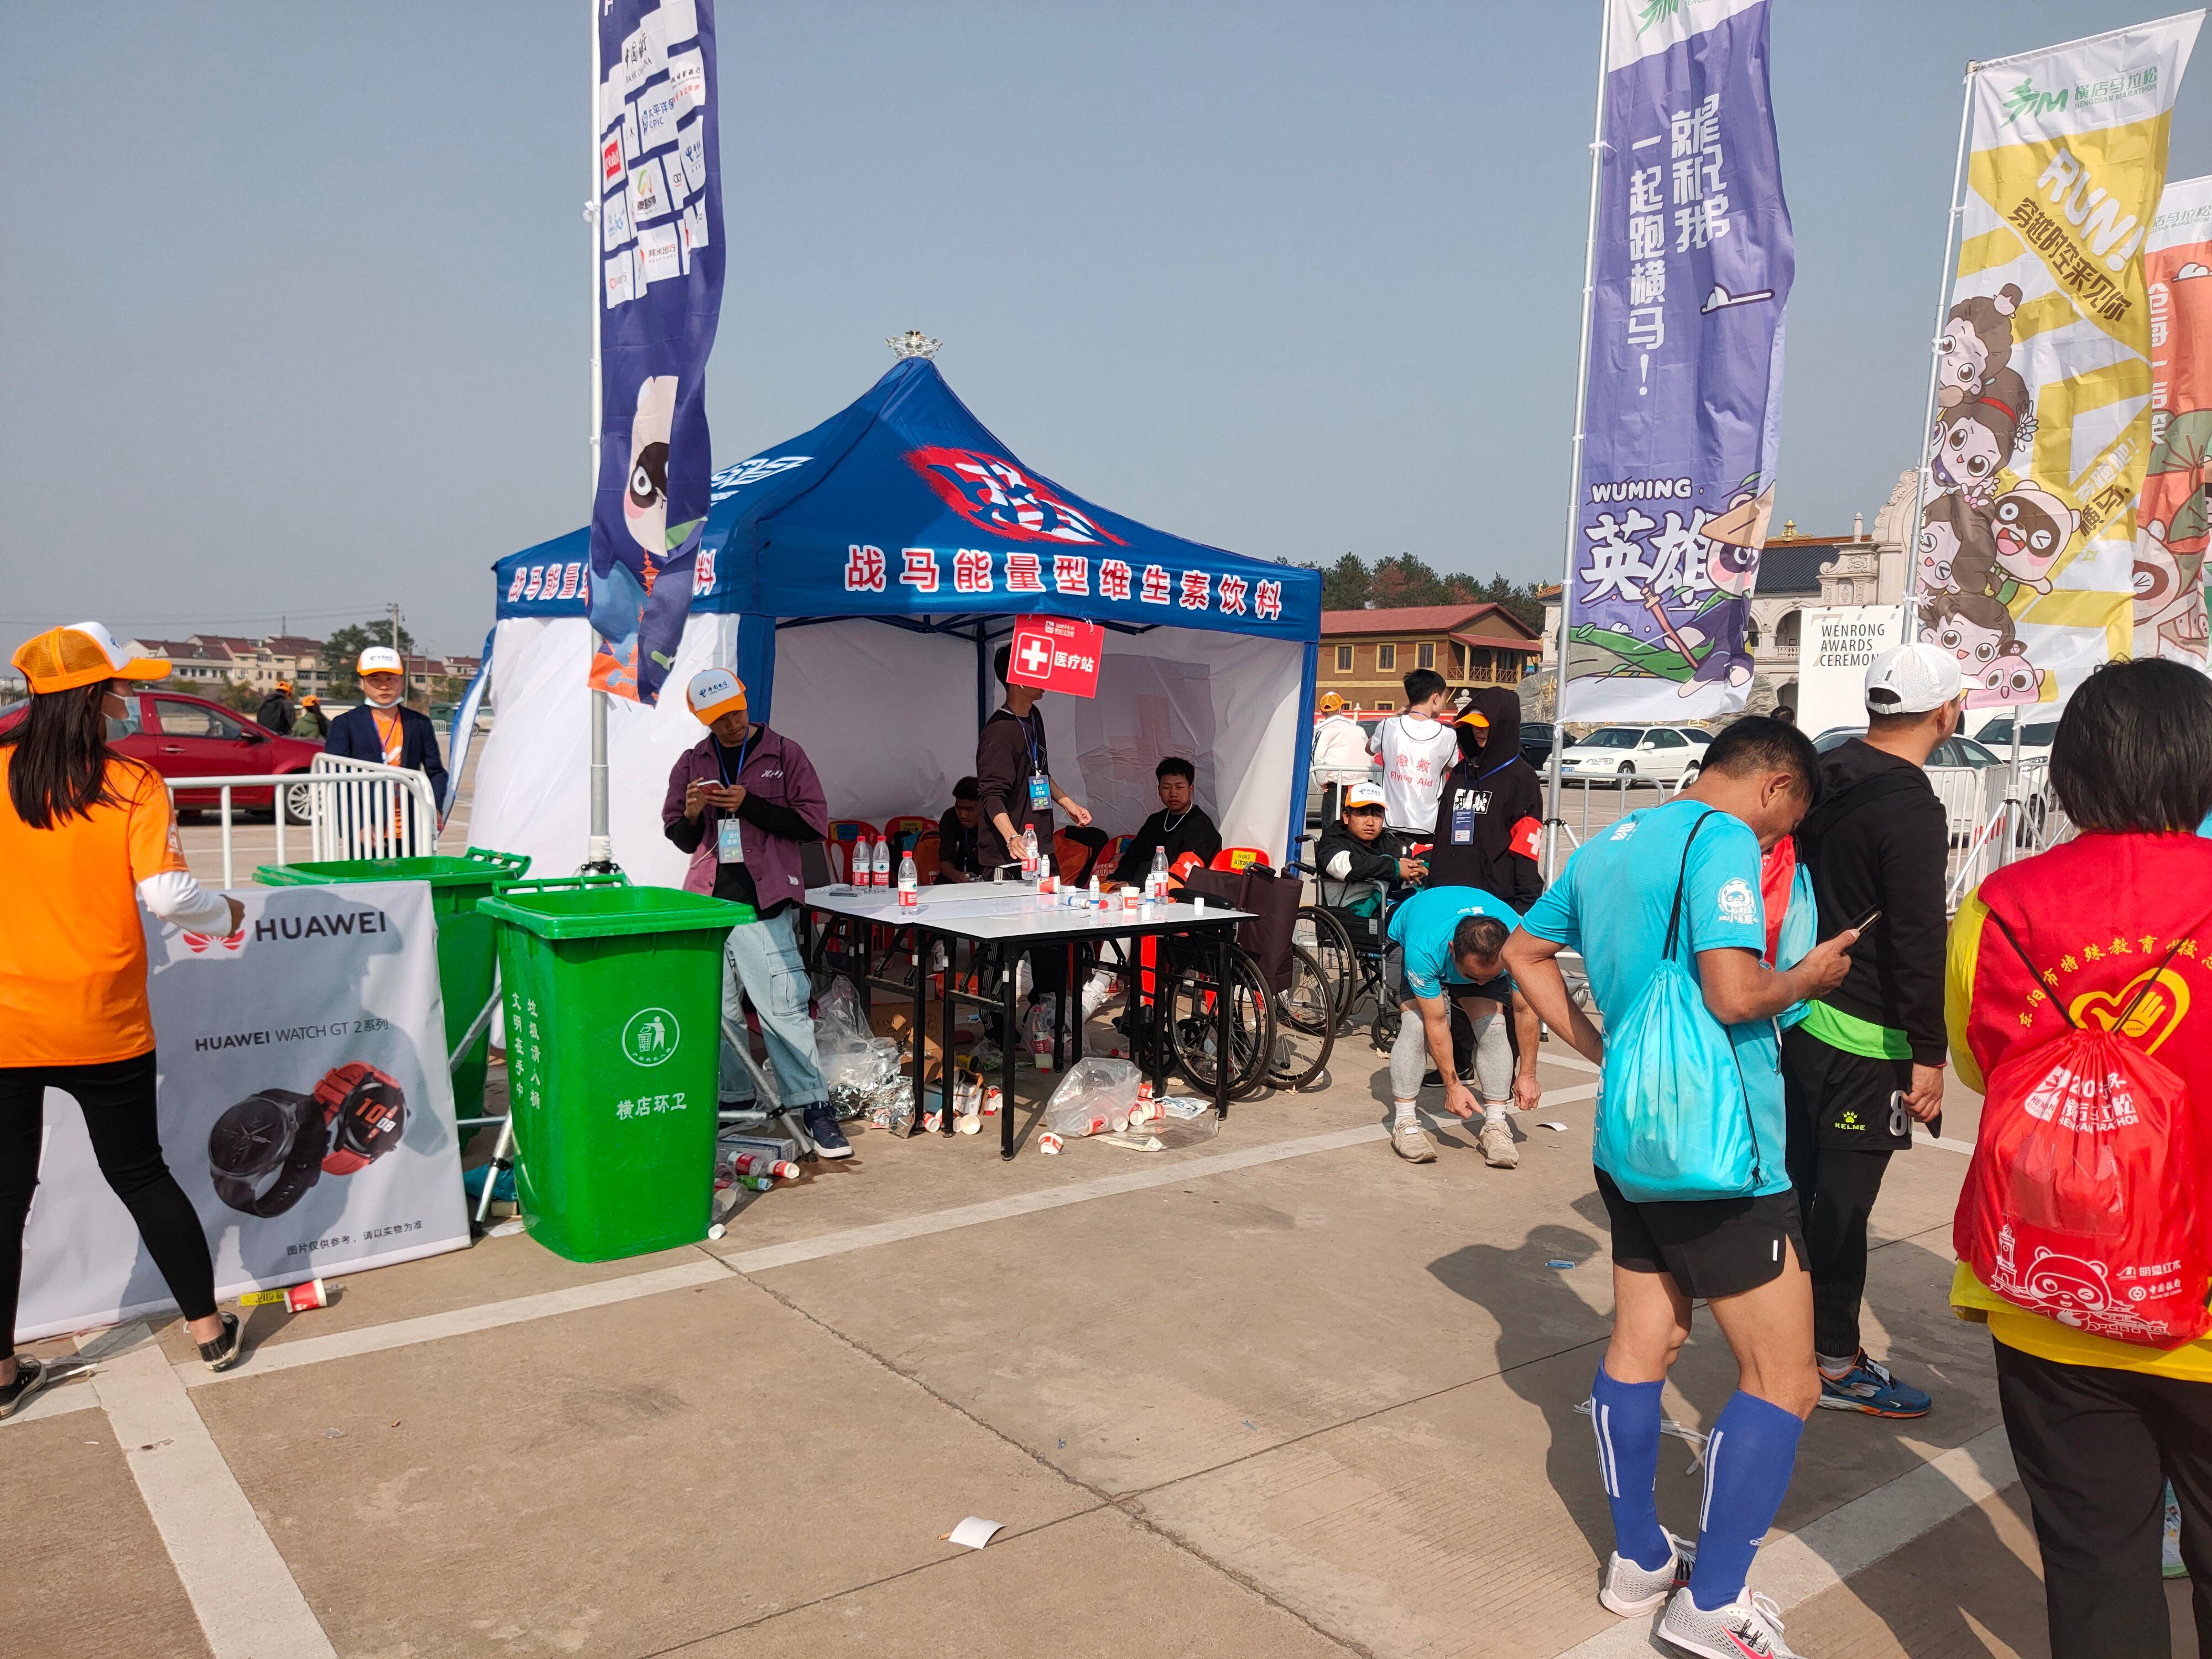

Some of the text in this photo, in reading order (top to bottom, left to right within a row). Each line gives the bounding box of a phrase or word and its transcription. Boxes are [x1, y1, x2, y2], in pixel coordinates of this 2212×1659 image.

[2074, 66, 2158, 101] 横店马拉松
[2074, 84, 2157, 109] HENGDIAN MARATHON
[2037, 147, 2146, 272] RUN!
[1592, 478, 1692, 503] WUMING
[845, 544, 1282, 621] 战马能量型维生素饮料
[1822, 623, 1885, 637] WENRONG
[1820, 639, 1873, 652] AWARDS
[1054, 651, 1094, 673] 医疗站
[1820, 654, 1879, 667] CEREMON
[1396, 753, 1432, 773] 急救
[1417, 778, 1434, 787] Aid
[255, 911, 387, 942] HUAWEI
[195, 1030, 270, 1052] HUAWEI
[275, 1024, 326, 1042] WATCH
[330, 1022, 349, 1036] GT
[356, 1097, 388, 1124] 10
[616, 1092, 687, 1121] 横店环卫
[1889, 1090, 1913, 1136] 8
